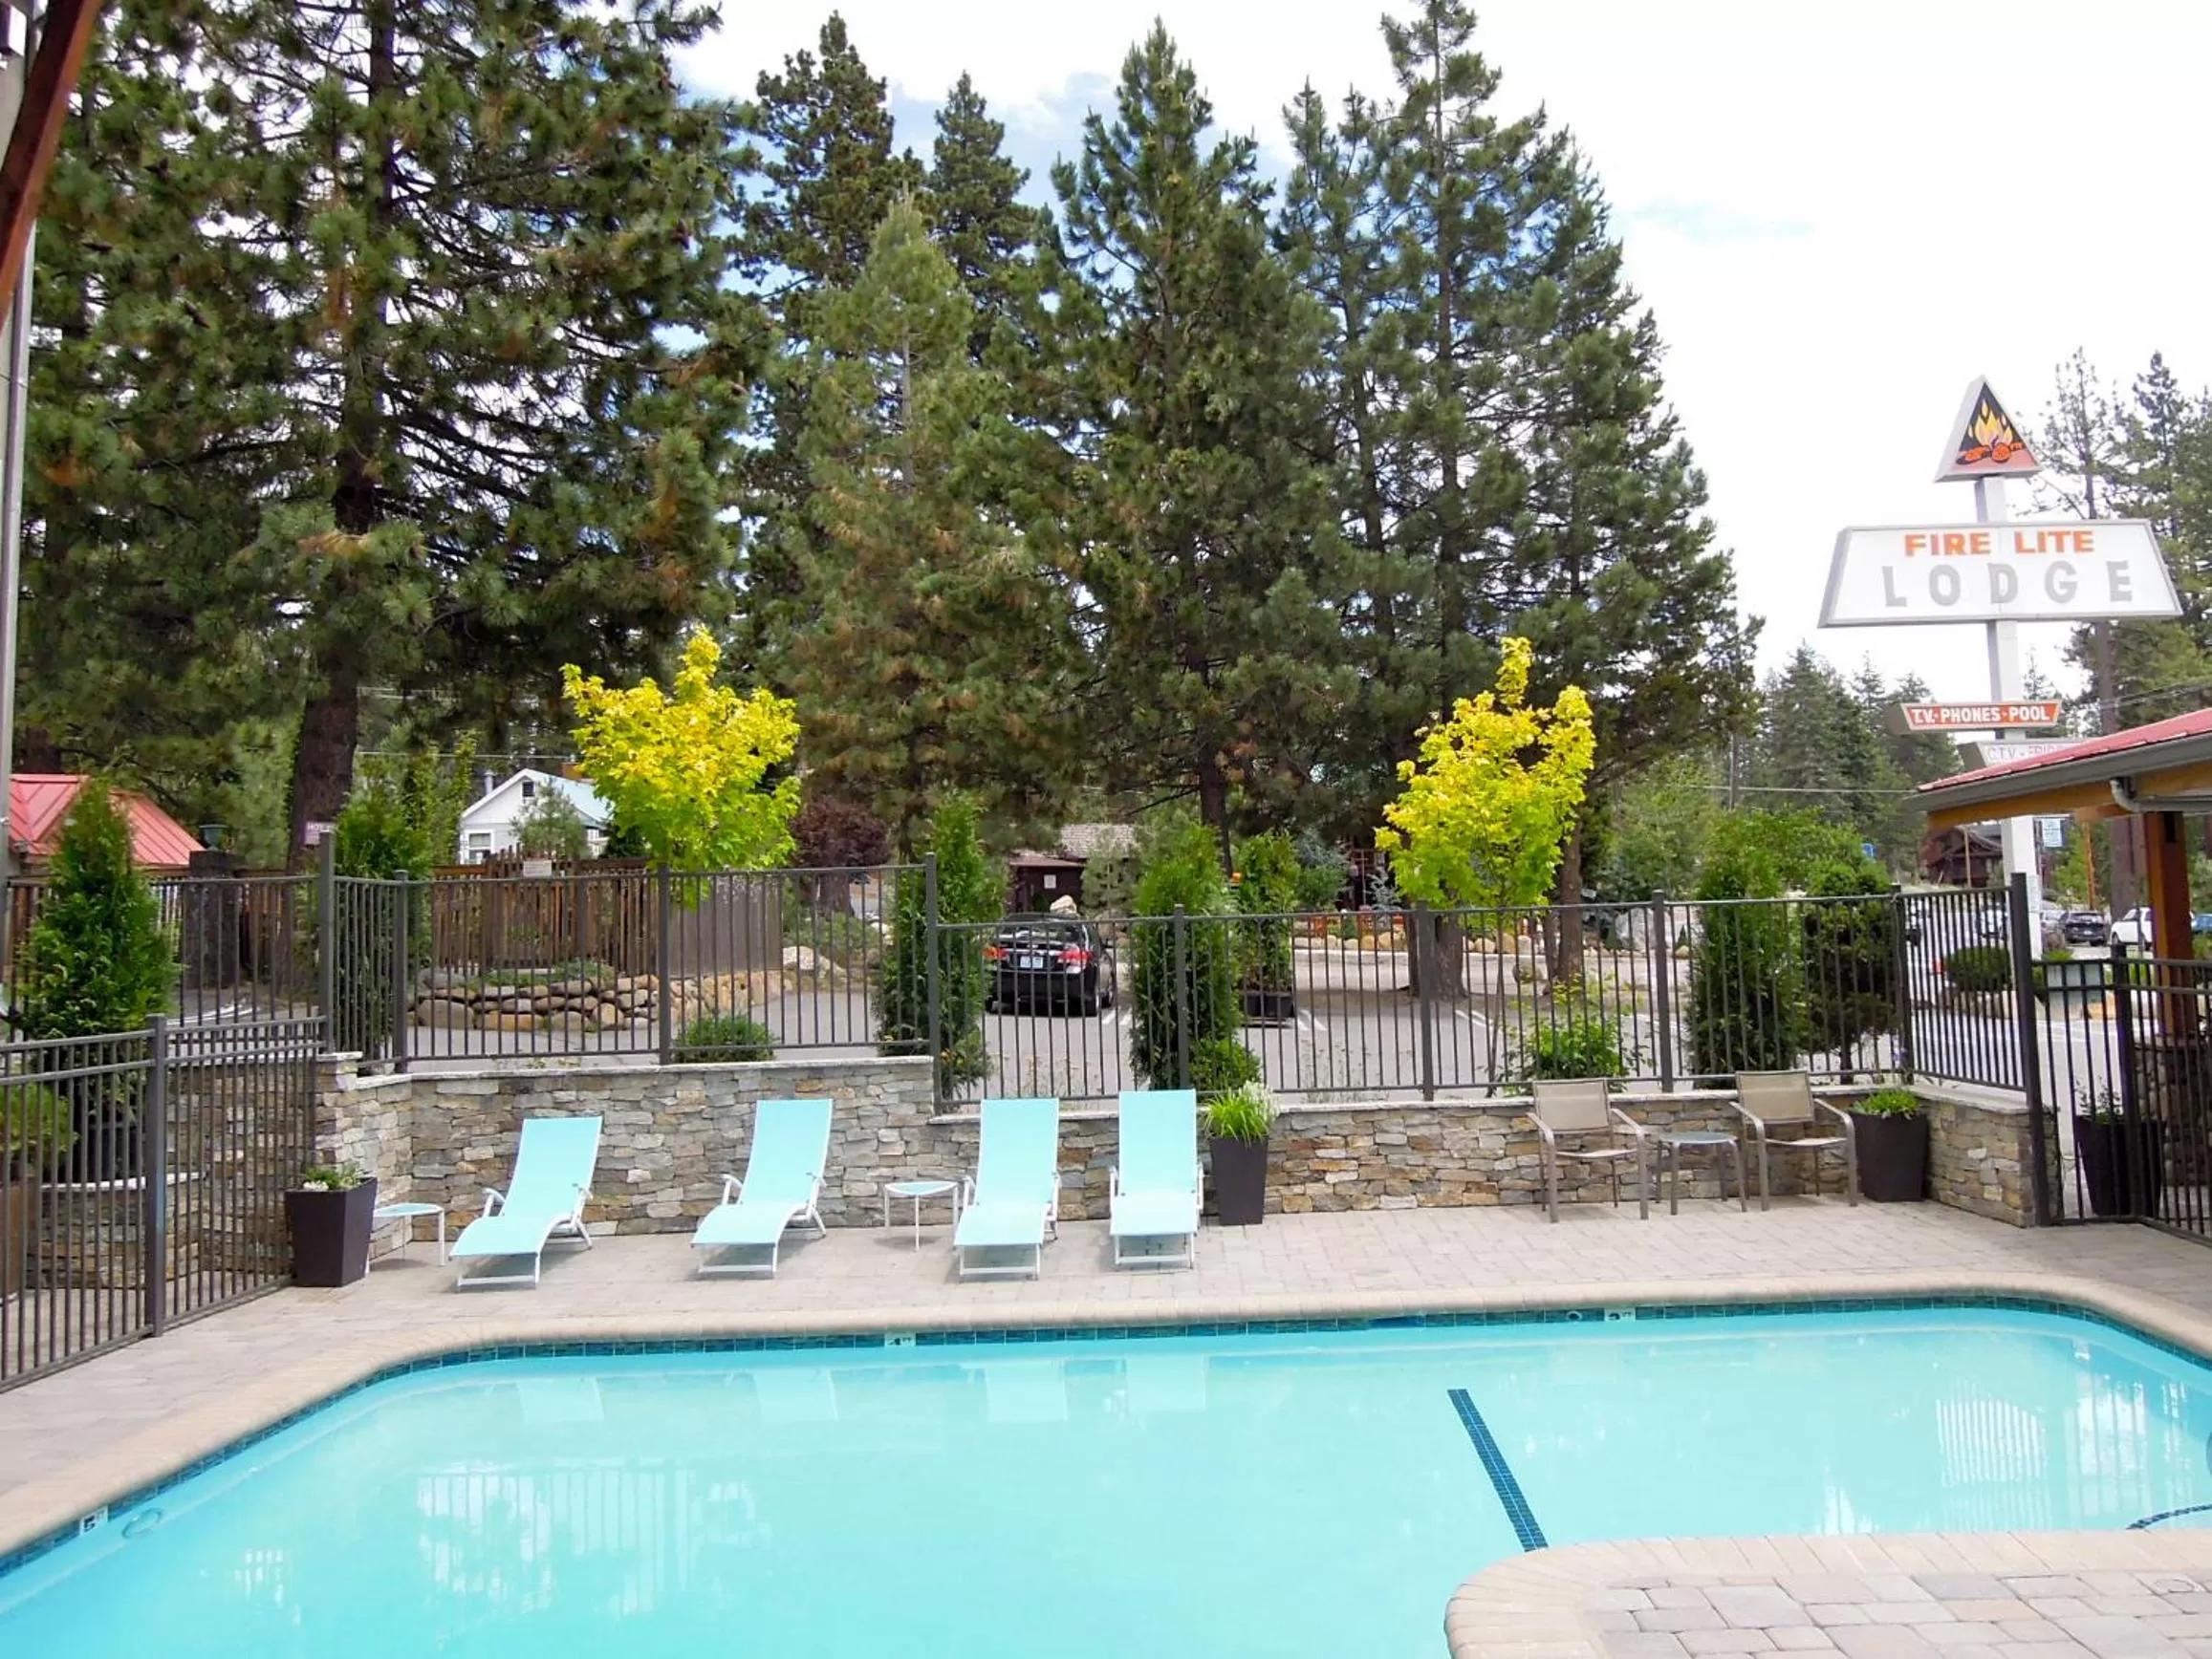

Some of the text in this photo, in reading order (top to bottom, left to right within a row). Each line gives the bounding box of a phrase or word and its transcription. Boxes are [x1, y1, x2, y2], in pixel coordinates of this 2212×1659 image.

[1904, 530, 2094, 556] FIRE LITE
[1881, 560, 2133, 607] LODGE
[1941, 706, 2001, 722] PHONES
[2008, 705, 2050, 722] POOL
